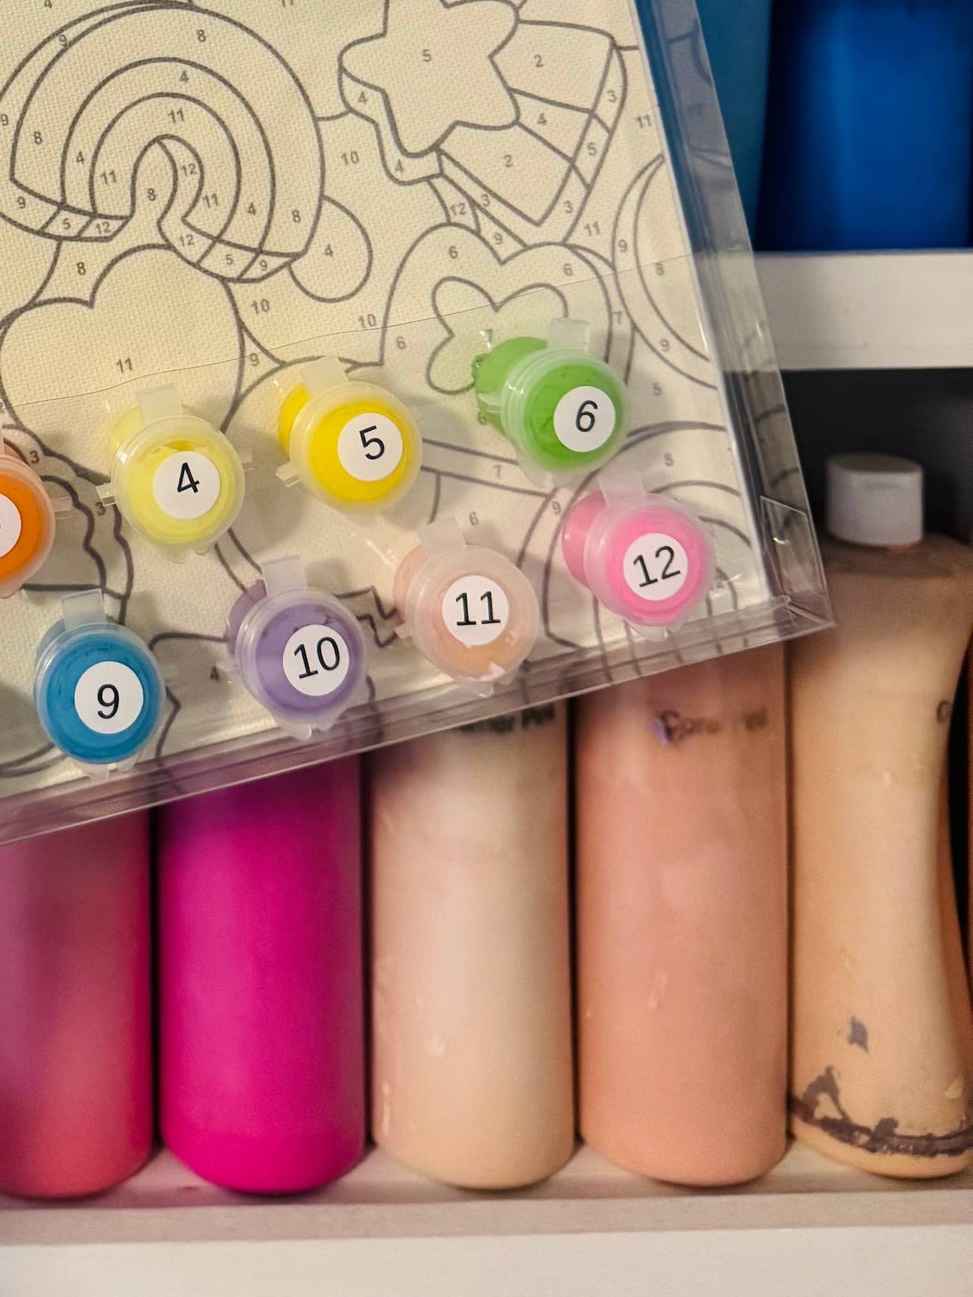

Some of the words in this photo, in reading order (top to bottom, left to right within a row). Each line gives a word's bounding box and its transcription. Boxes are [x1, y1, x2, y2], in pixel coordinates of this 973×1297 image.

[197, 29, 206, 42] 8
[422, 49, 432, 62] 5
[535, 54, 543, 68] 2
[180, 70, 189, 83] 4
[358, 91, 368, 105] 4
[607, 89, 617, 103] 3
[0, 113, 9, 127] 9
[168, 109, 184, 123] 11
[537, 113, 547, 126] 4
[636, 115, 651, 128] 11
[33, 131, 43, 145] 8
[587, 142, 597, 156] 5
[75, 151, 85, 165] 4
[341, 151, 359, 165] 10
[503, 154, 513, 168] 2
[180, 162, 197, 177] 12
[396, 160, 404, 173] 4
[101, 170, 117, 184] 11
[147, 188, 157, 201] 8
[203, 193, 219, 207] 11
[17, 196, 26, 209] 9
[247, 202, 257, 216] 4
[564, 200, 573, 214] 3
[292, 210, 301, 223] 8
[63, 218, 71, 230] 5
[584, 221, 600, 236] 11
[178, 233, 195, 248] 12
[493, 232, 503, 245] 9
[618, 239, 628, 252] 9
[325, 244, 333, 257] 4
[448, 246, 458, 259] 6
[225, 253, 234, 265] 5
[259, 260, 269, 272] 9
[76, 262, 86, 275] 8
[563, 263, 573, 276] 6
[251, 298, 270, 314] 10
[358, 314, 377, 331] 10
[396, 336, 406, 350] 6
[116, 357, 132, 372] 11
[249, 353, 259, 367] 9
[576, 400, 598, 432] 6
[360, 426, 385, 460] 5
[177, 463, 199, 493] 4
[634, 546, 680, 587] 12
[456, 592, 500, 626] 11
[295, 637, 340, 678] 10
[98, 684, 119, 719] 9
